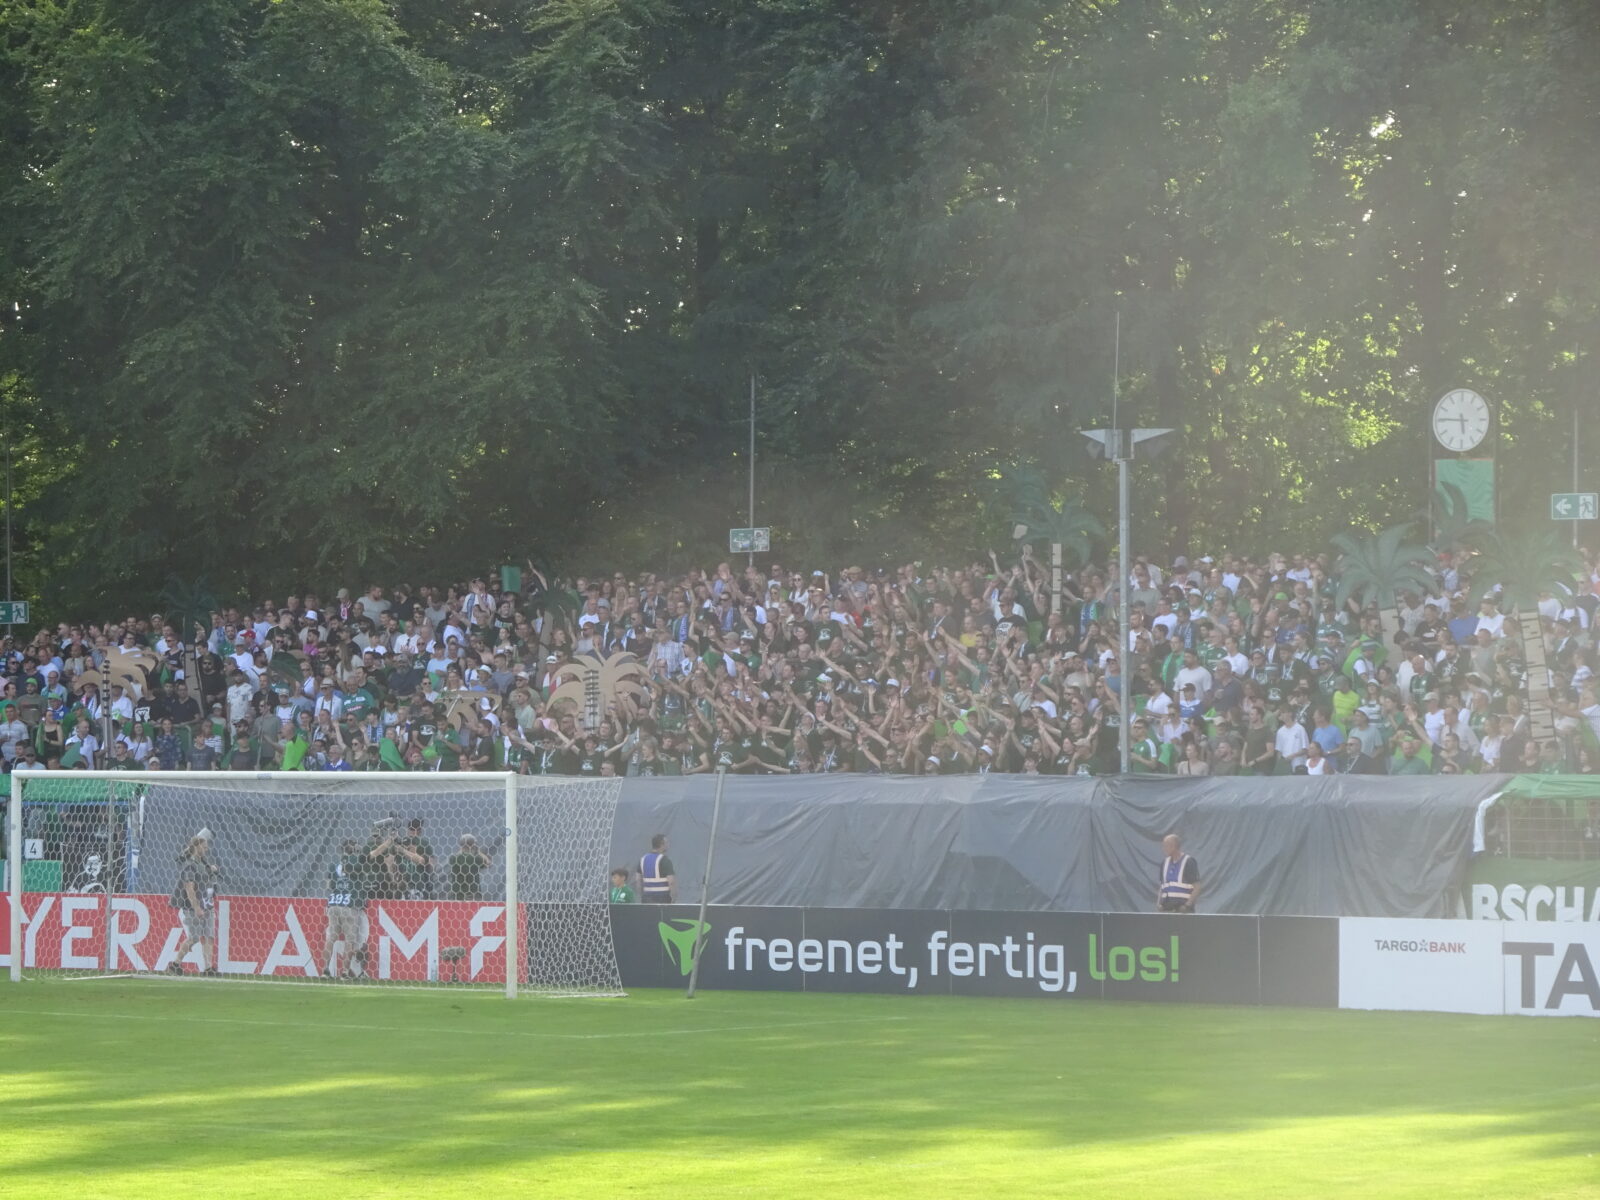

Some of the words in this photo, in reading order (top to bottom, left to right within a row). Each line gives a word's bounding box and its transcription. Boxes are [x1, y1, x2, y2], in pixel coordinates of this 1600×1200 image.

[29, 842, 37, 855] 4
[0, 896, 439, 980] YERALAM
[725, 926, 918, 988] freenet,
[928, 930, 1077, 992] fertig,
[1089, 933, 1180, 983] los!
